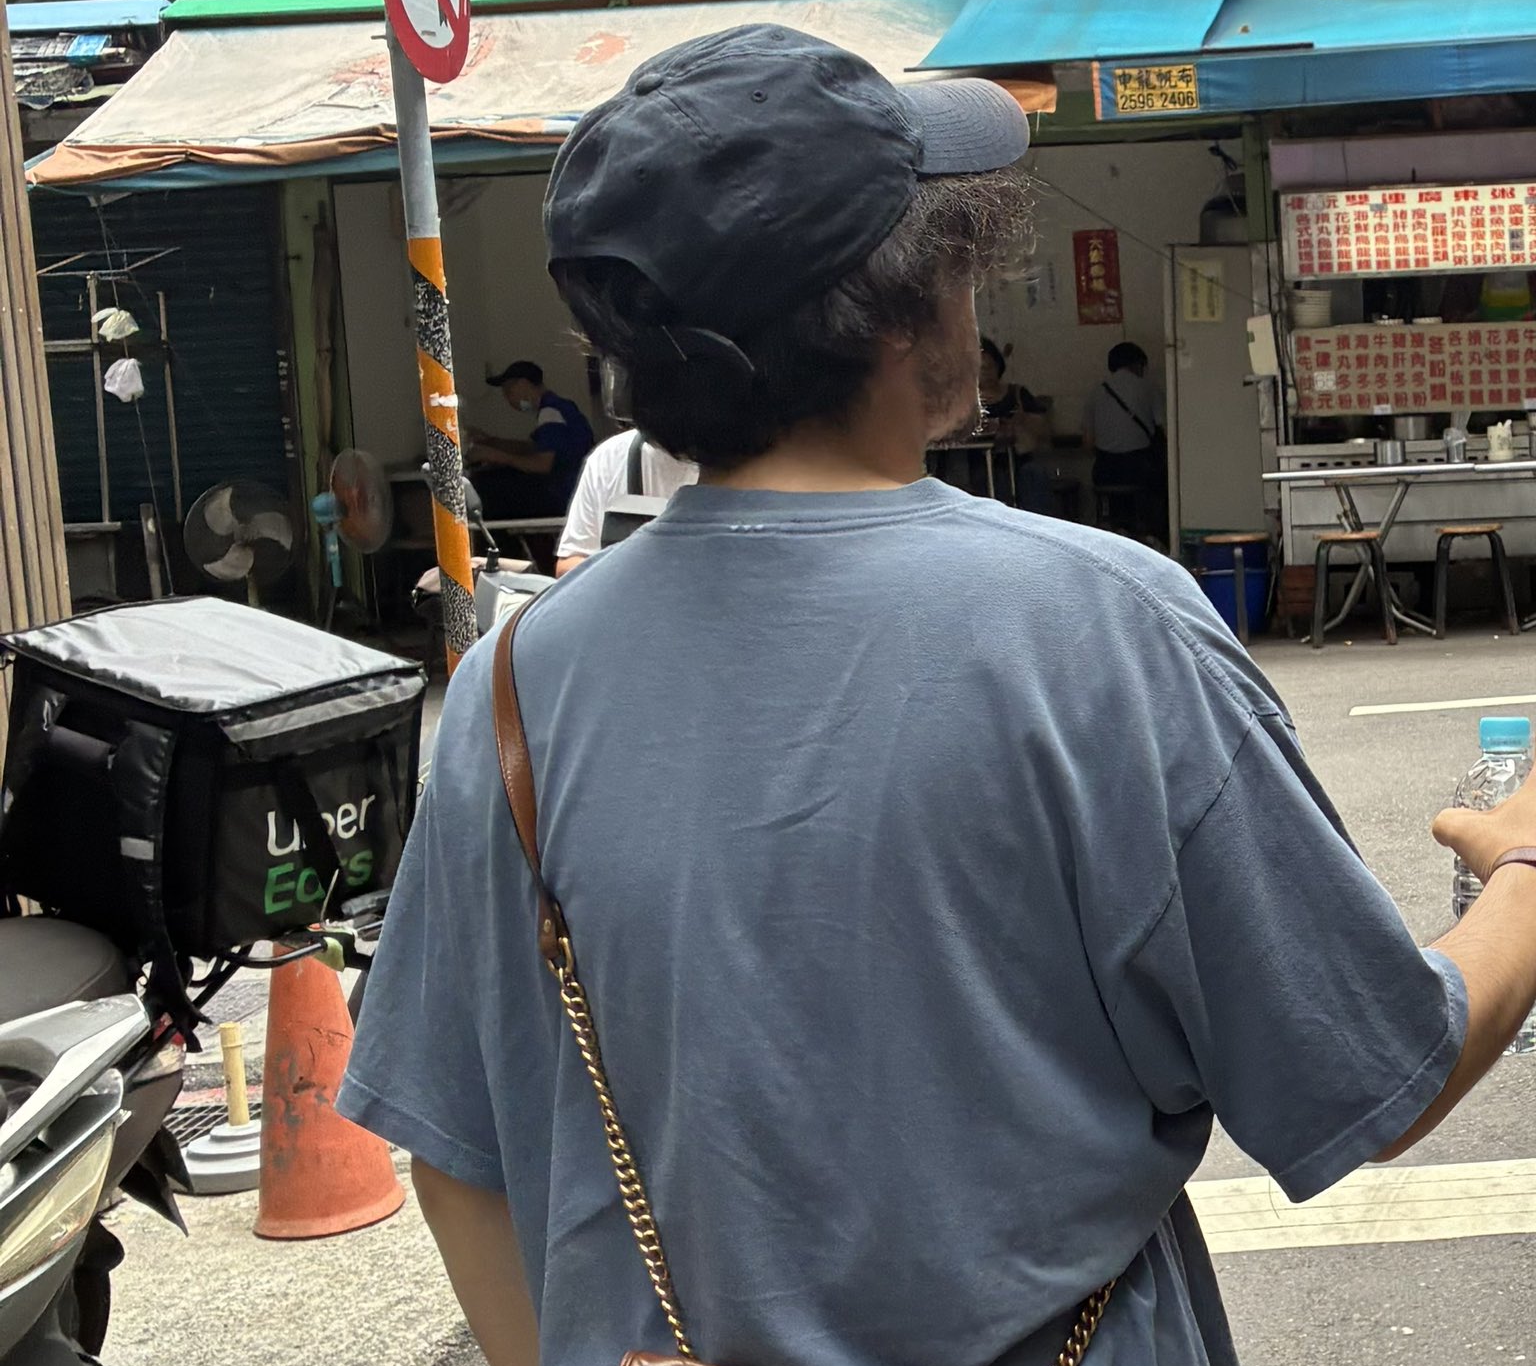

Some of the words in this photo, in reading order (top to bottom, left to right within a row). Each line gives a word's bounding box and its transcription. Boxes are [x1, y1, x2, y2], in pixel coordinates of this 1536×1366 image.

[1120, 92, 1155, 110] 2596
[1160, 90, 1195, 108] 2406
[264, 849, 373, 915] Eas
